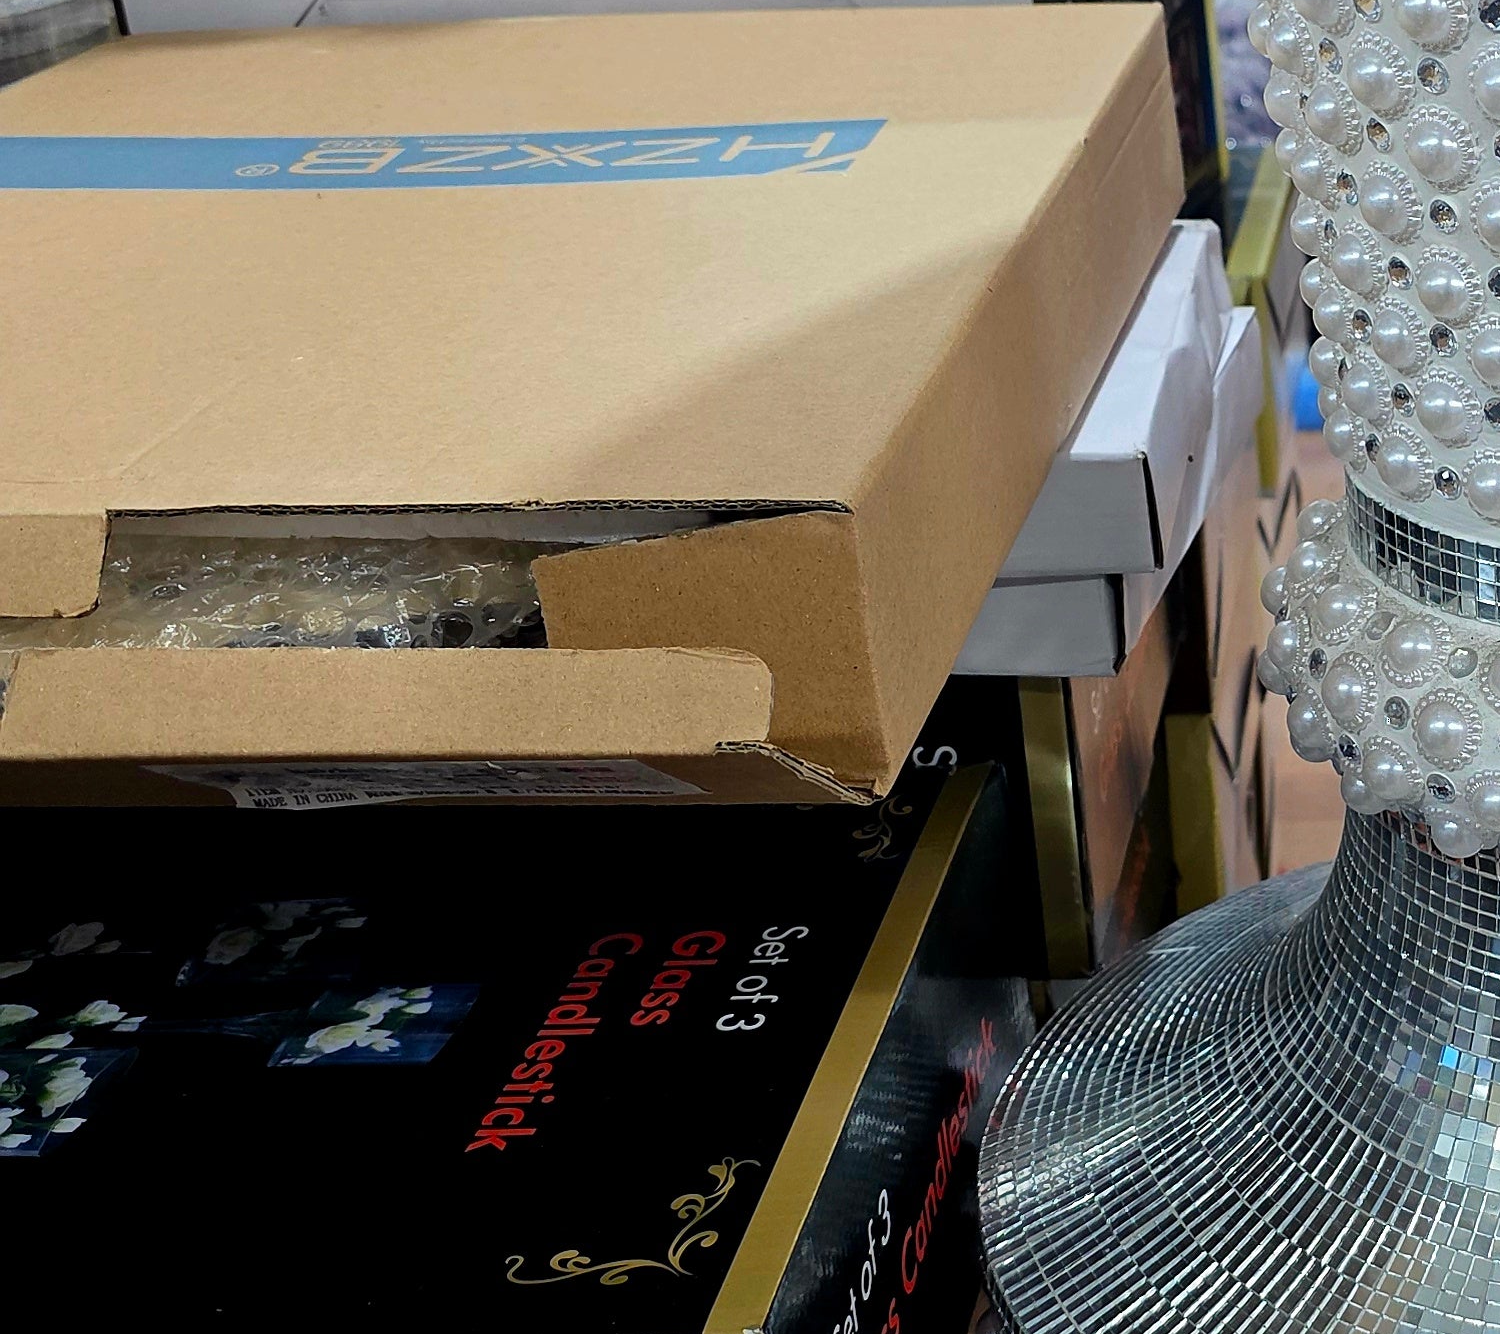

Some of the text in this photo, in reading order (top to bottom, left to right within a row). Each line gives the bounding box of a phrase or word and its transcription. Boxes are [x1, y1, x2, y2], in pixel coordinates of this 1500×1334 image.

[252, 796, 288, 808] MADE
[295, 795, 311, 806] IN
[316, 791, 359, 804] CHINA
[629, 929, 727, 1027] Glass
[715, 925, 810, 1032] Set of 3
[463, 931, 645, 1153] Candlestick
[901, 1016, 996, 1296] Candlestick
[860, 1216, 879, 1302] of
[877, 1188, 891, 1247] 3
